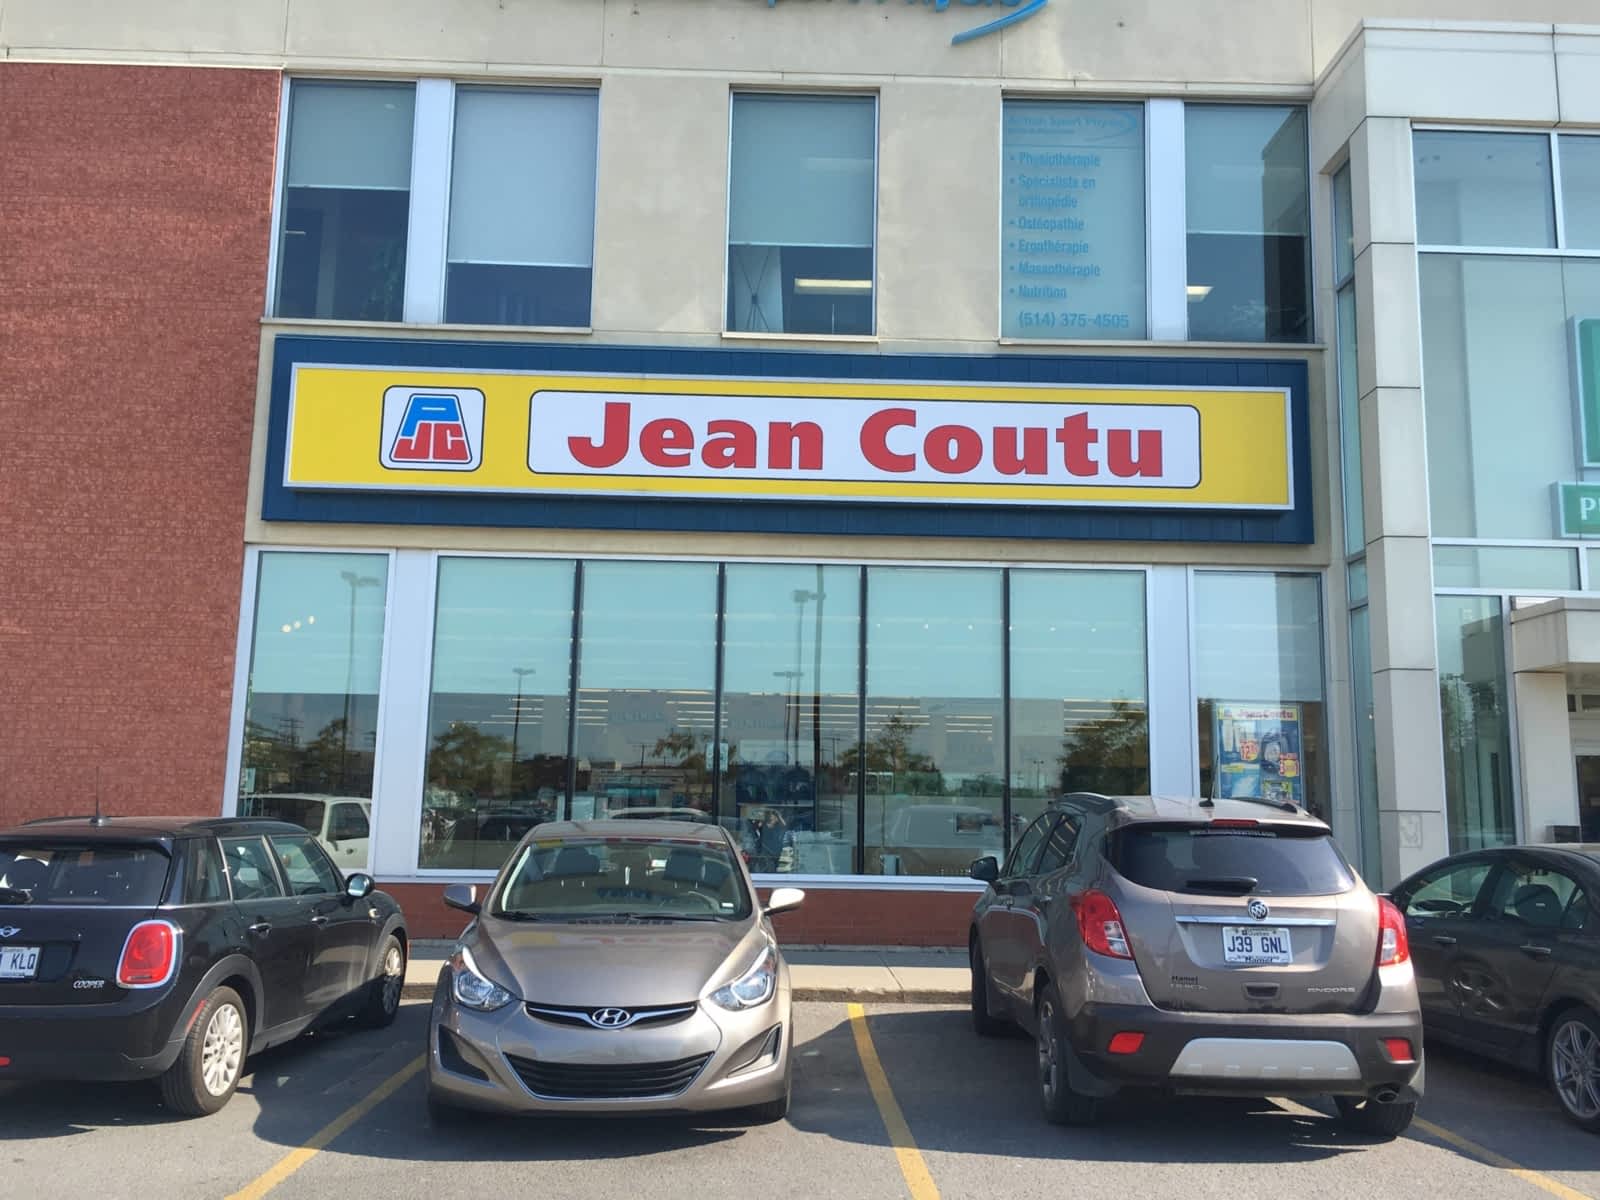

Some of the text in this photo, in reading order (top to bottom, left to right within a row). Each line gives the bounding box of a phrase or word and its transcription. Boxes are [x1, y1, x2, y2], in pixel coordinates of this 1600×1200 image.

[1083, 179, 1096, 189] en
[1018, 284, 1067, 299] Nutrition
[1018, 311, 1129, 328] (514) 375-4505
[568, 402, 1164, 478] Jean Coutu
[1580, 497, 1600, 520] P
[1228, 936, 1287, 953] J39 GNL
[73, 980, 105, 989] COOPER
